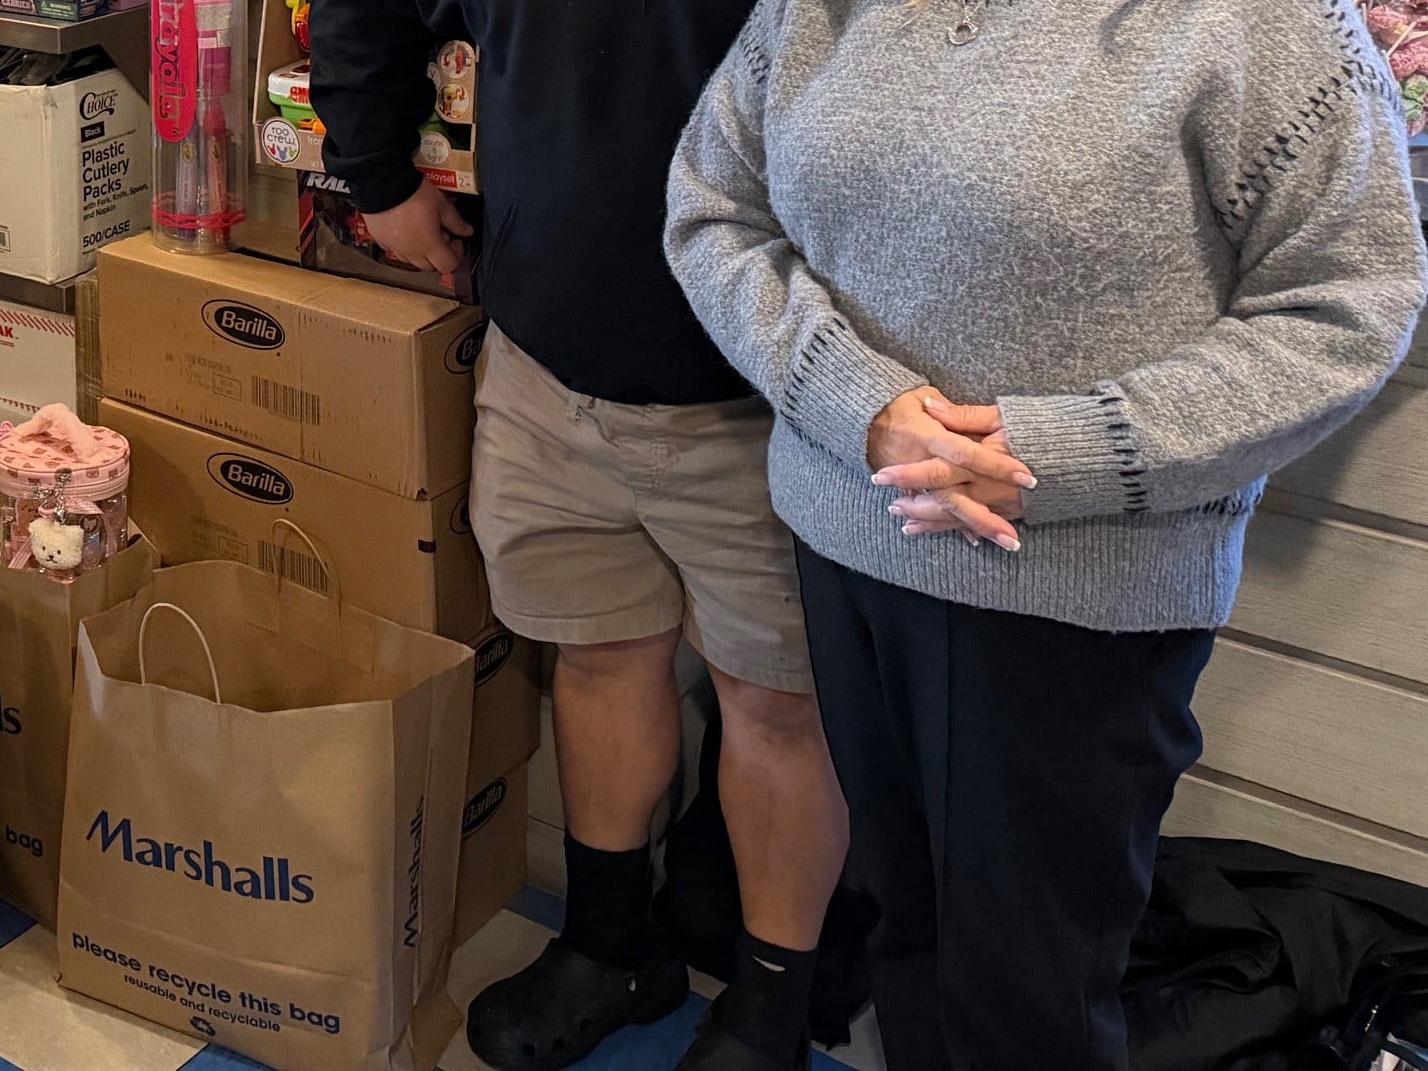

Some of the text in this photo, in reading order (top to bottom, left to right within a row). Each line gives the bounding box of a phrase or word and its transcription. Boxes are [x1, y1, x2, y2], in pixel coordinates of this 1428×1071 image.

[84, 126, 101, 138] Black
[272, 126, 290, 136] roo
[82, 141, 124, 167] Plastic
[82, 158, 130, 184] Cutlery
[426, 172, 455, 184] playset
[83, 178, 121, 201] Packs
[83, 183, 149, 211] with Fork, Knife, Spoon,
[83, 204, 116, 221] and Napkin
[83, 220, 131, 247] 500/CASE
[221, 310, 278, 340] Barilla
[227, 464, 285, 496] Barilla
[5, 824, 44, 858] bag
[86, 810, 315, 904] Marshalls
[72, 932, 341, 1035] please recycle this bag
[124, 974, 281, 1033] reusable and recyclable
